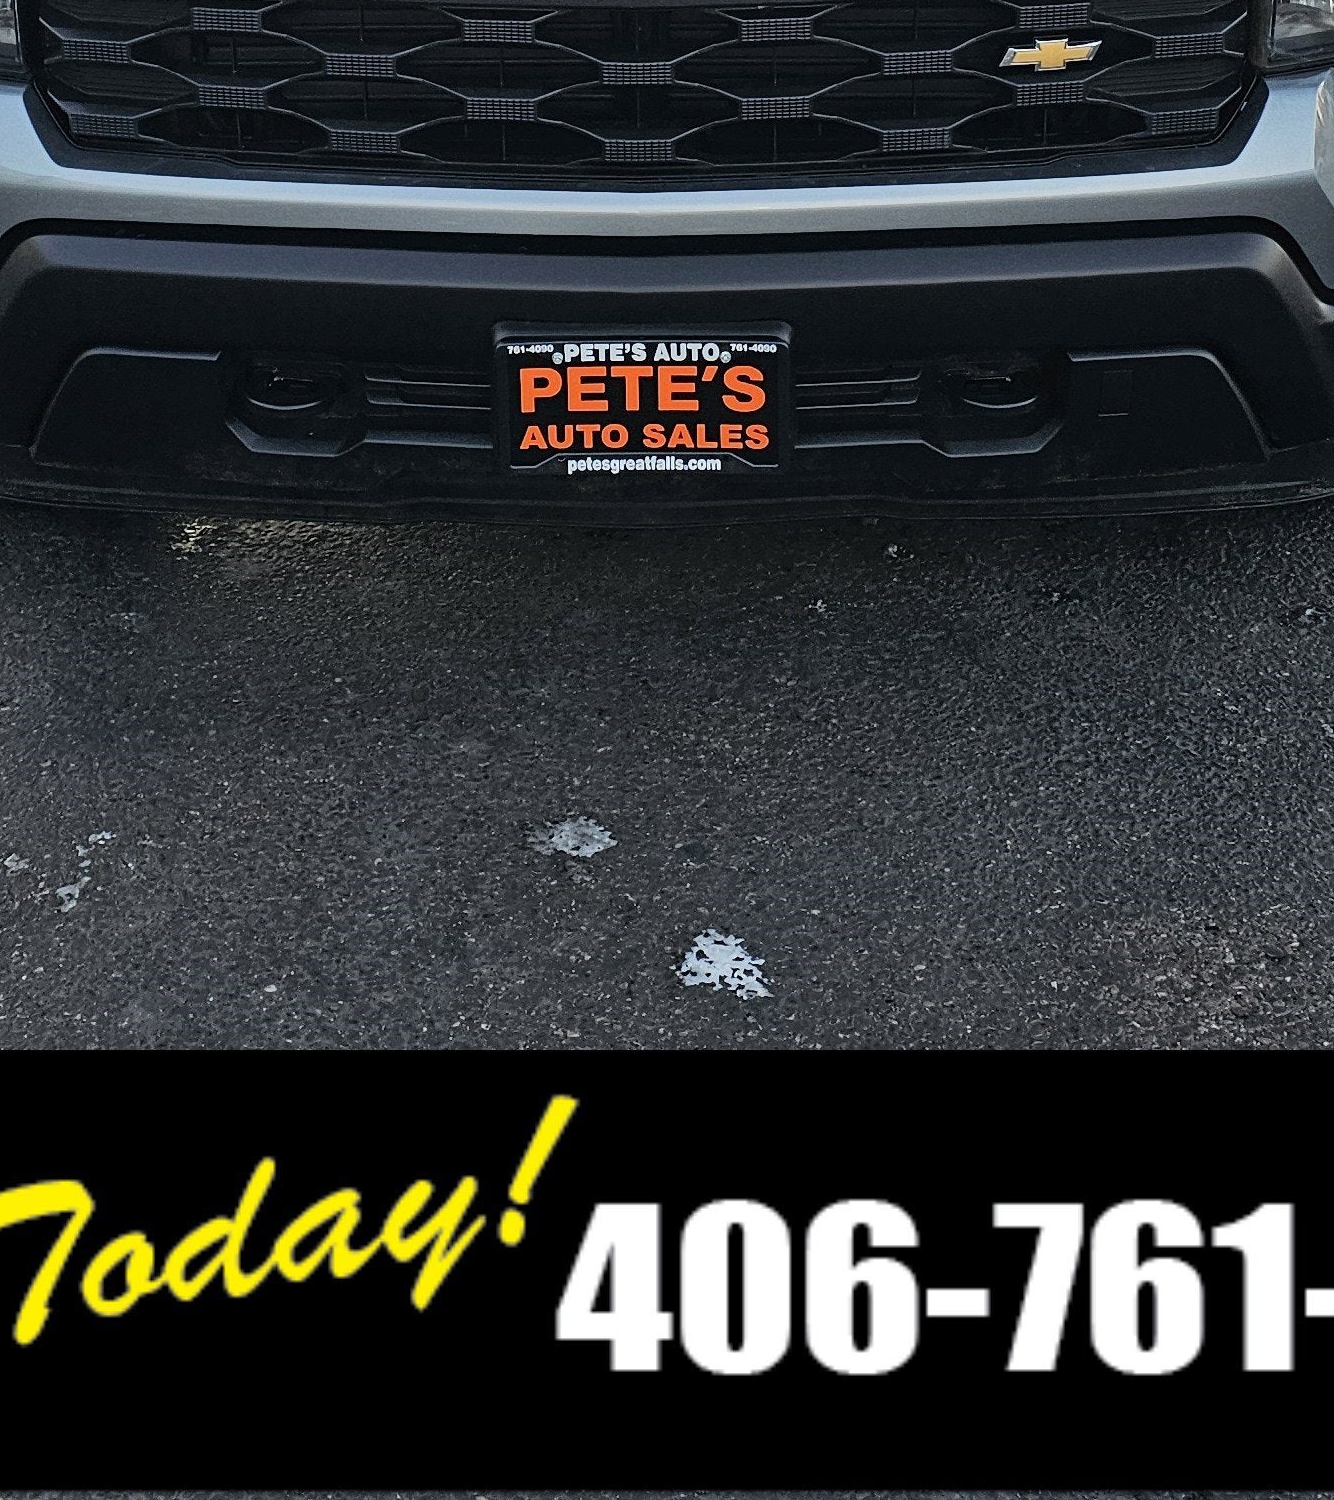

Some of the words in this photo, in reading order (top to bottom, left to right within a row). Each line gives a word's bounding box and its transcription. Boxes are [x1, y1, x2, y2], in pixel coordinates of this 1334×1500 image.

[564, 344, 647, 362] PETE'S
[654, 343, 720, 362] AUTO
[519, 365, 766, 413] PETE'S
[519, 424, 629, 449] AUTO
[642, 424, 769, 450] SALES
[567, 456, 722, 475] petesgreatfalls.com
